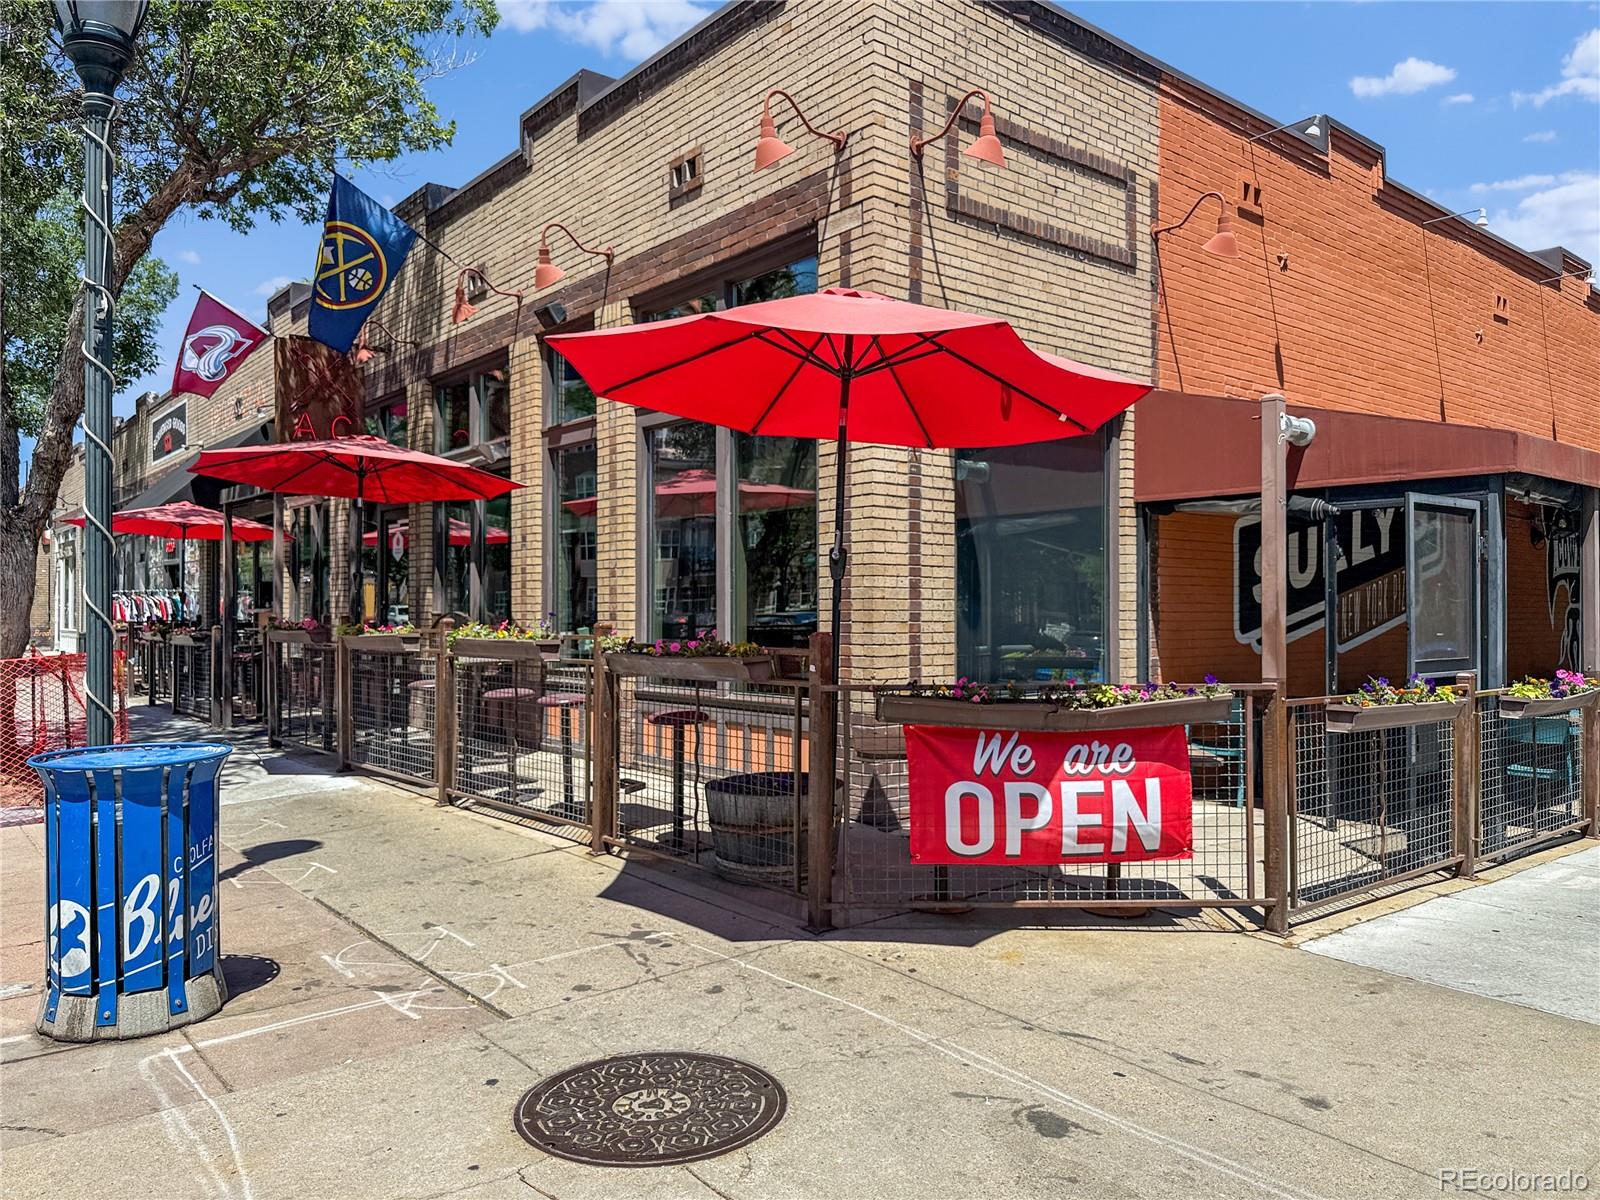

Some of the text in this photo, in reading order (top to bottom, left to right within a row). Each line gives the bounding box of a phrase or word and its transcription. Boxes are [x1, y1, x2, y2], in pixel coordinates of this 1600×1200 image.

[1341, 591, 1361, 640] NEW
[1366, 578, 1389, 628] YORK
[972, 731, 1136, 777] We are
[944, 777, 1161, 857] OPEN
[123, 873, 213, 962] Blue
